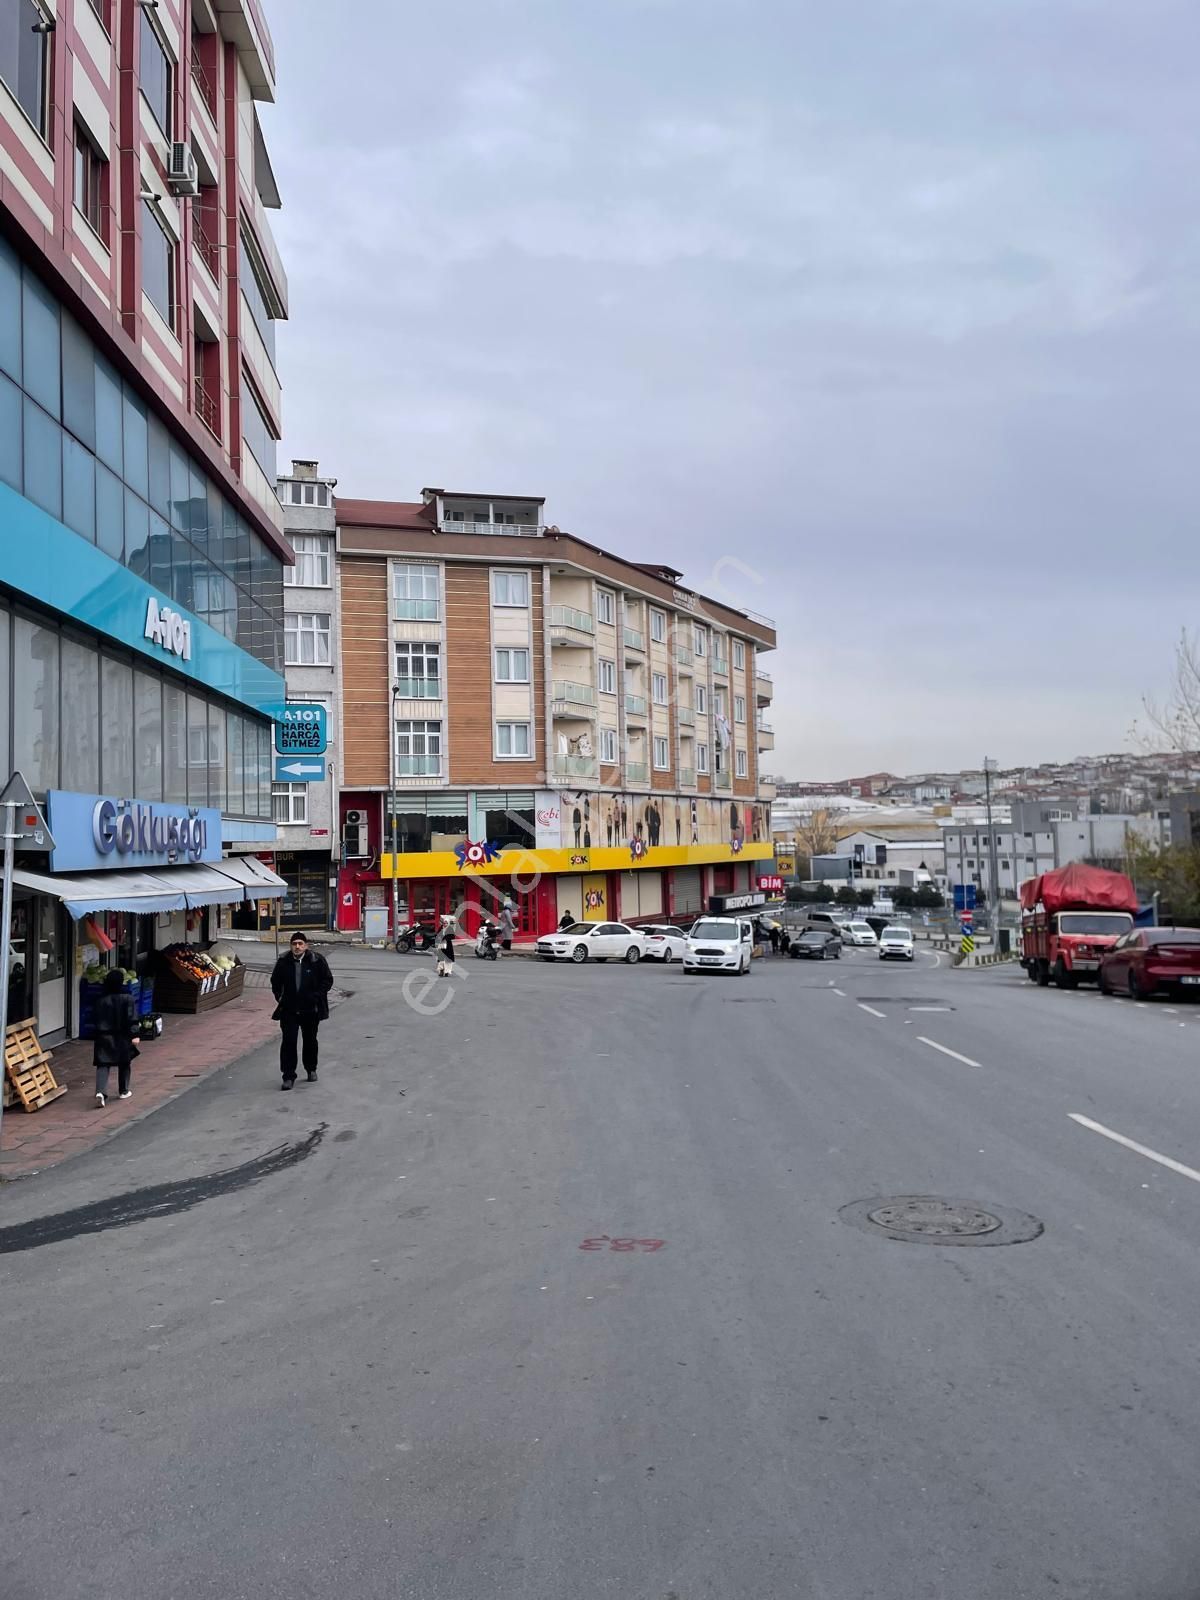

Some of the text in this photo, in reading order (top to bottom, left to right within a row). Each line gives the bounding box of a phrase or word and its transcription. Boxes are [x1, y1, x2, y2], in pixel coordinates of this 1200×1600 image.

[282, 723, 320, 731] HARCA
[282, 731, 320, 739] HARCA
[92, 799, 208, 864] Gökkuşağı
